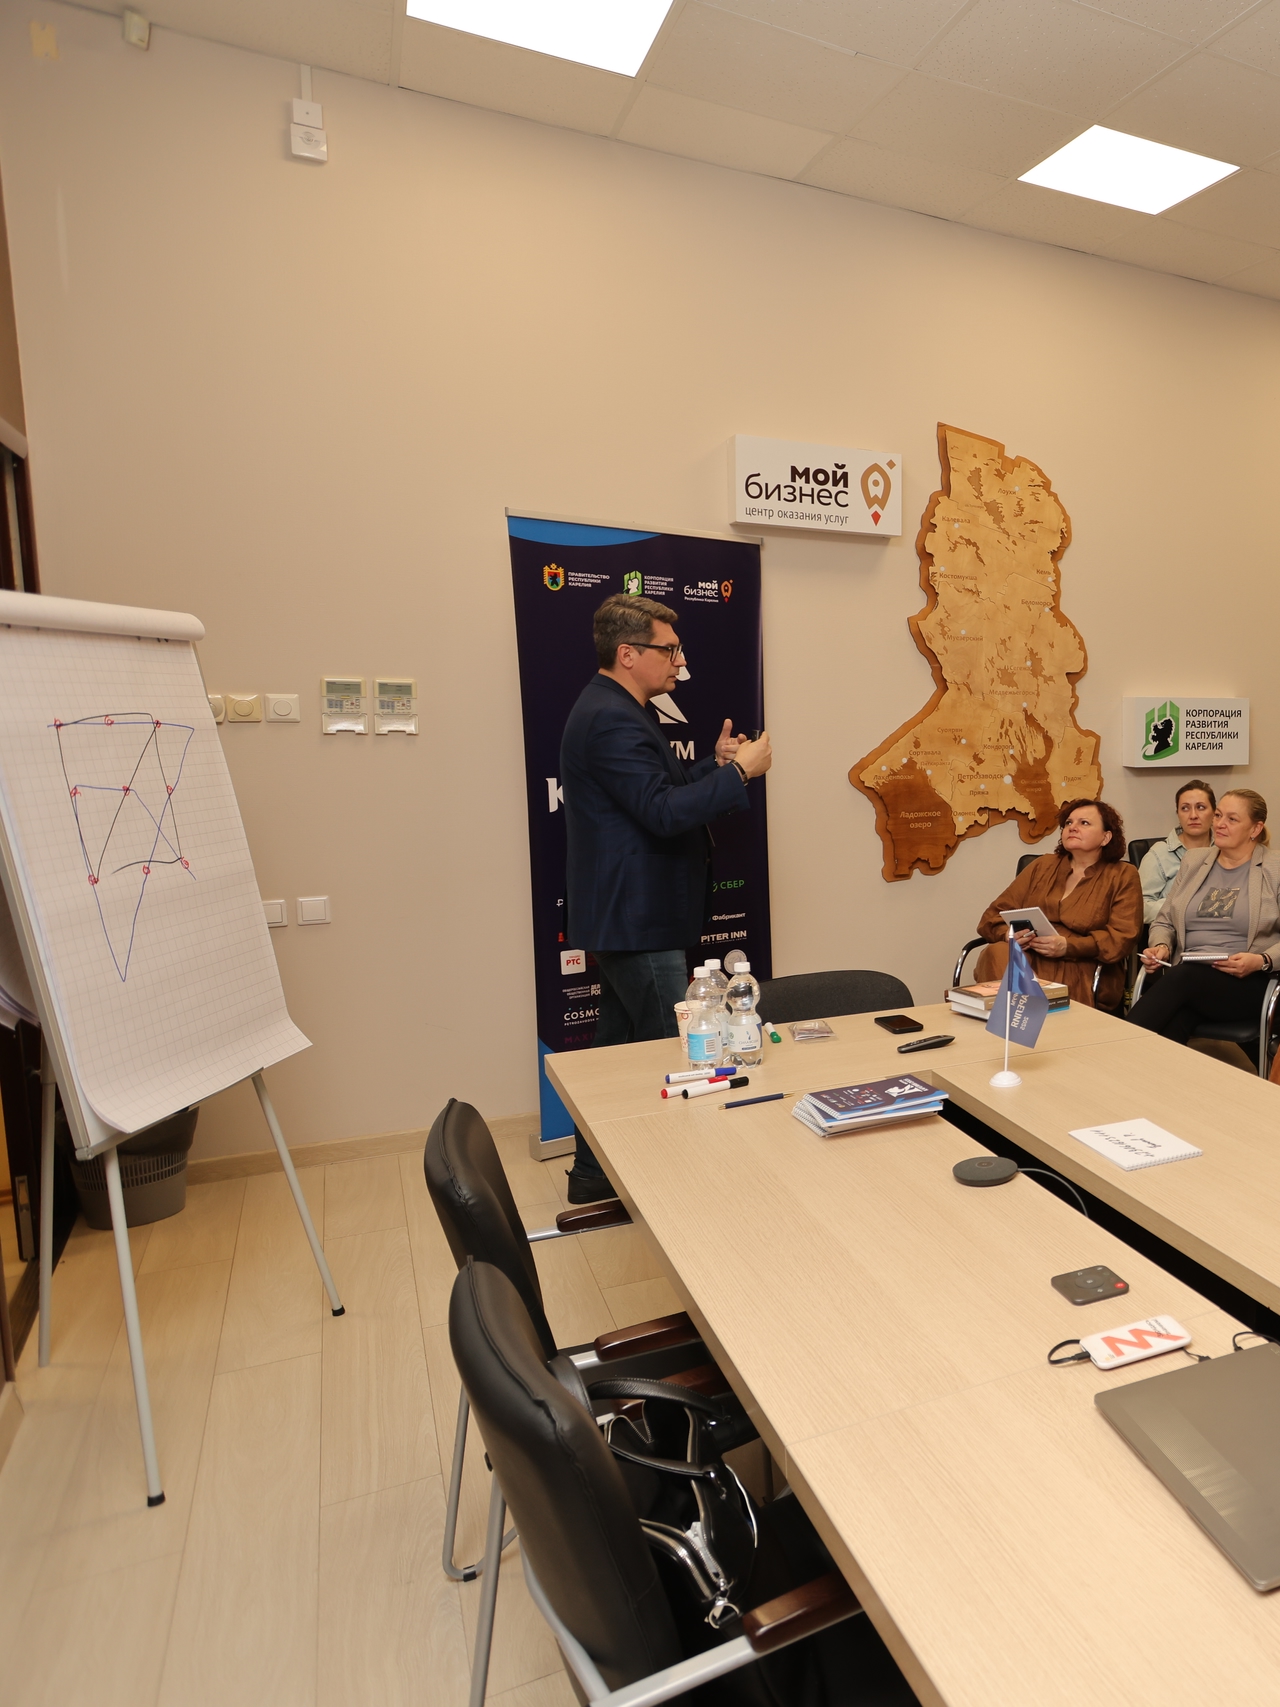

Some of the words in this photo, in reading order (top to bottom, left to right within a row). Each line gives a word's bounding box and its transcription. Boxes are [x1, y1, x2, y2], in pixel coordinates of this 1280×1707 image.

[790, 462, 849, 489] мой
[744, 472, 849, 508] бизнес
[745, 506, 774, 520] центр
[777, 508, 822, 522] оказания
[824, 513, 849, 526] услуг
[568, 571, 610, 580] ПРАВИТЕЛЬСТВО
[568, 576, 602, 584] РЕСПУБЛИКИ
[698, 580, 718, 589] мой
[683, 585, 719, 598] бизнес
[1185, 709, 1242, 719] КОРПОРАЦИЯ
[1185, 720, 1229, 729] РАЗВИТИЯ
[1185, 731, 1239, 740] РЕСПУБЛИКИ
[1185, 742, 1223, 751] КАРЕЛИЯ
[957, 773, 1004, 782] Петрозаводск
[900, 810, 942, 819] Ладожское
[720, 880, 745, 890] СБЕР
[711, 912, 746, 921] Фабрикант
[700, 932, 729, 943] PITER
[730, 930, 747, 939] INN
[566, 957, 581, 967] РТС
